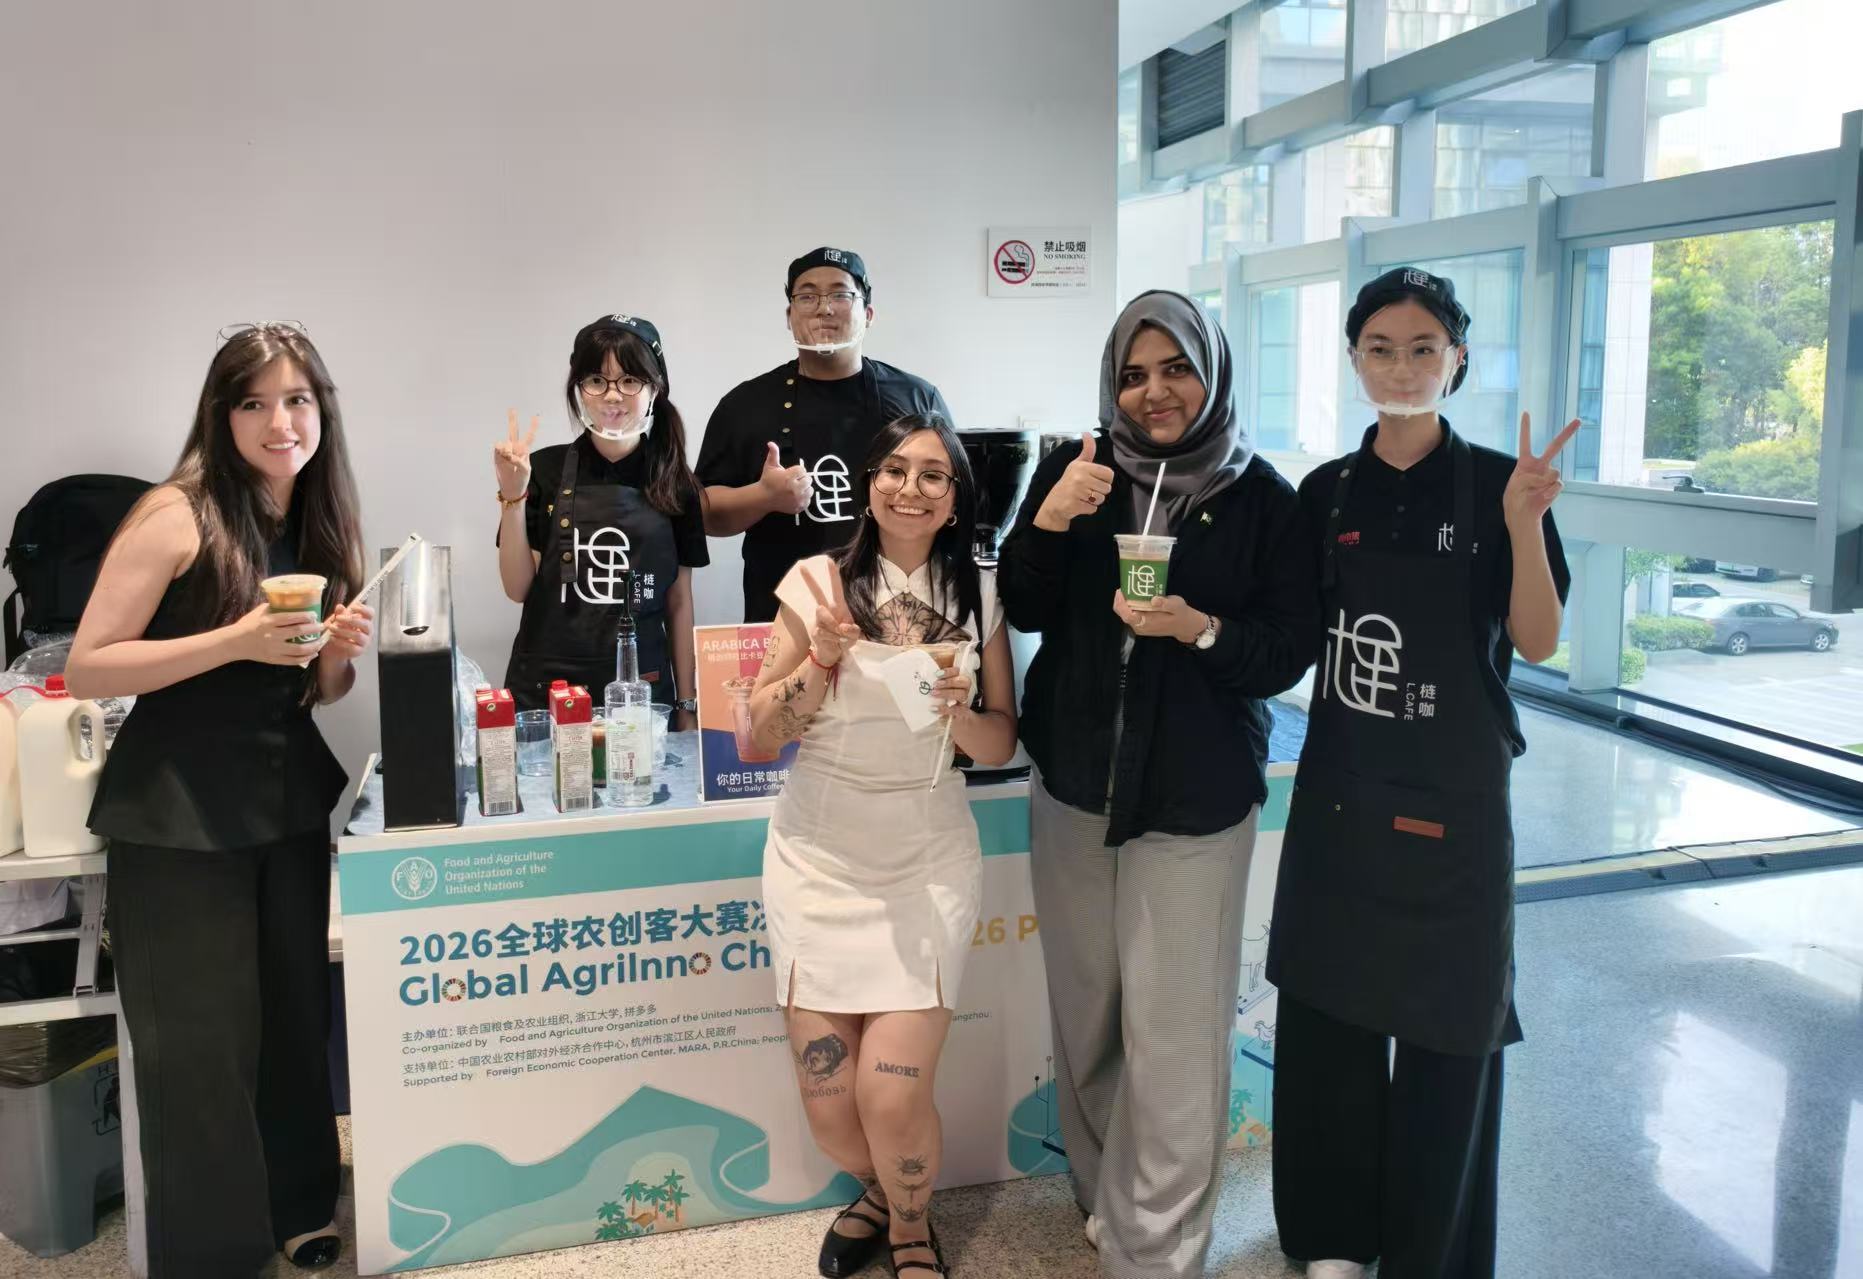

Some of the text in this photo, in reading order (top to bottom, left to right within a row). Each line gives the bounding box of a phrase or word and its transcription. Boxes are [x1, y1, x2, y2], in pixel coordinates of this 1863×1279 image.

[1044, 241, 1086, 252] 禁止吸烟
[703, 638, 760, 652] ARABICA
[716, 768, 791, 786] 你的日常咖啡
[744, 784, 761, 792] Daily
[444, 850, 554, 868] Food and Agriculture
[445, 864, 546, 882] Organization of the
[445, 880, 524, 895] United Nations
[399, 963, 528, 1007] Global
[541, 951, 712, 996] AgriInno
[402, 1039, 472, 1055] Co-organized
[475, 1038, 488, 1048] by
[500, 1032, 525, 1044] Food
[527, 1031, 547, 1041] and
[549, 1024, 604, 1039] Agriculture
[606, 1017, 668, 1032] Organization
[670, 1014, 681, 1024] of
[683, 1012, 698, 1022] the
[701, 1010, 732, 1020] United
[403, 1072, 458, 1087] Supported
[461, 1071, 473, 1081] by
[486, 1064, 524, 1077] Foreign
[527, 1058, 576, 1072] Economic
[578, 1050, 639, 1066] Cooperation
[875, 1061, 920, 1078] AMORE
